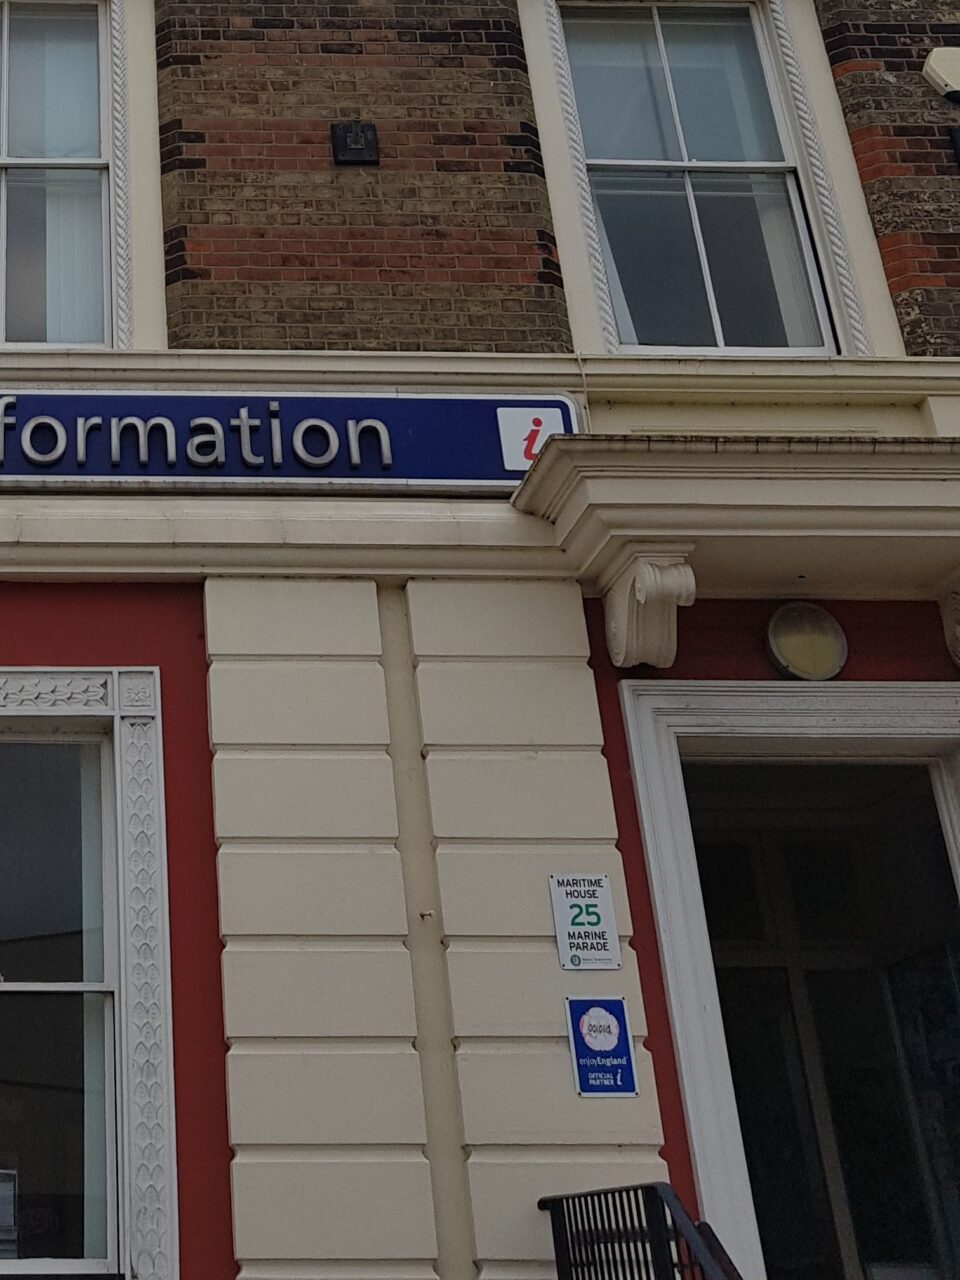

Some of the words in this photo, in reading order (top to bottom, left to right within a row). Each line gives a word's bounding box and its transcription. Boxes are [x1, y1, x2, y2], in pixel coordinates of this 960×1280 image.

[556, 878, 604, 888] MARITIME
[565, 889, 599, 899] HOUSE
[569, 903, 601, 927] 25
[567, 931, 608, 941] MARINE
[569, 942, 610, 952] PARADE
[589, 1078, 615, 1086] PARTNER
